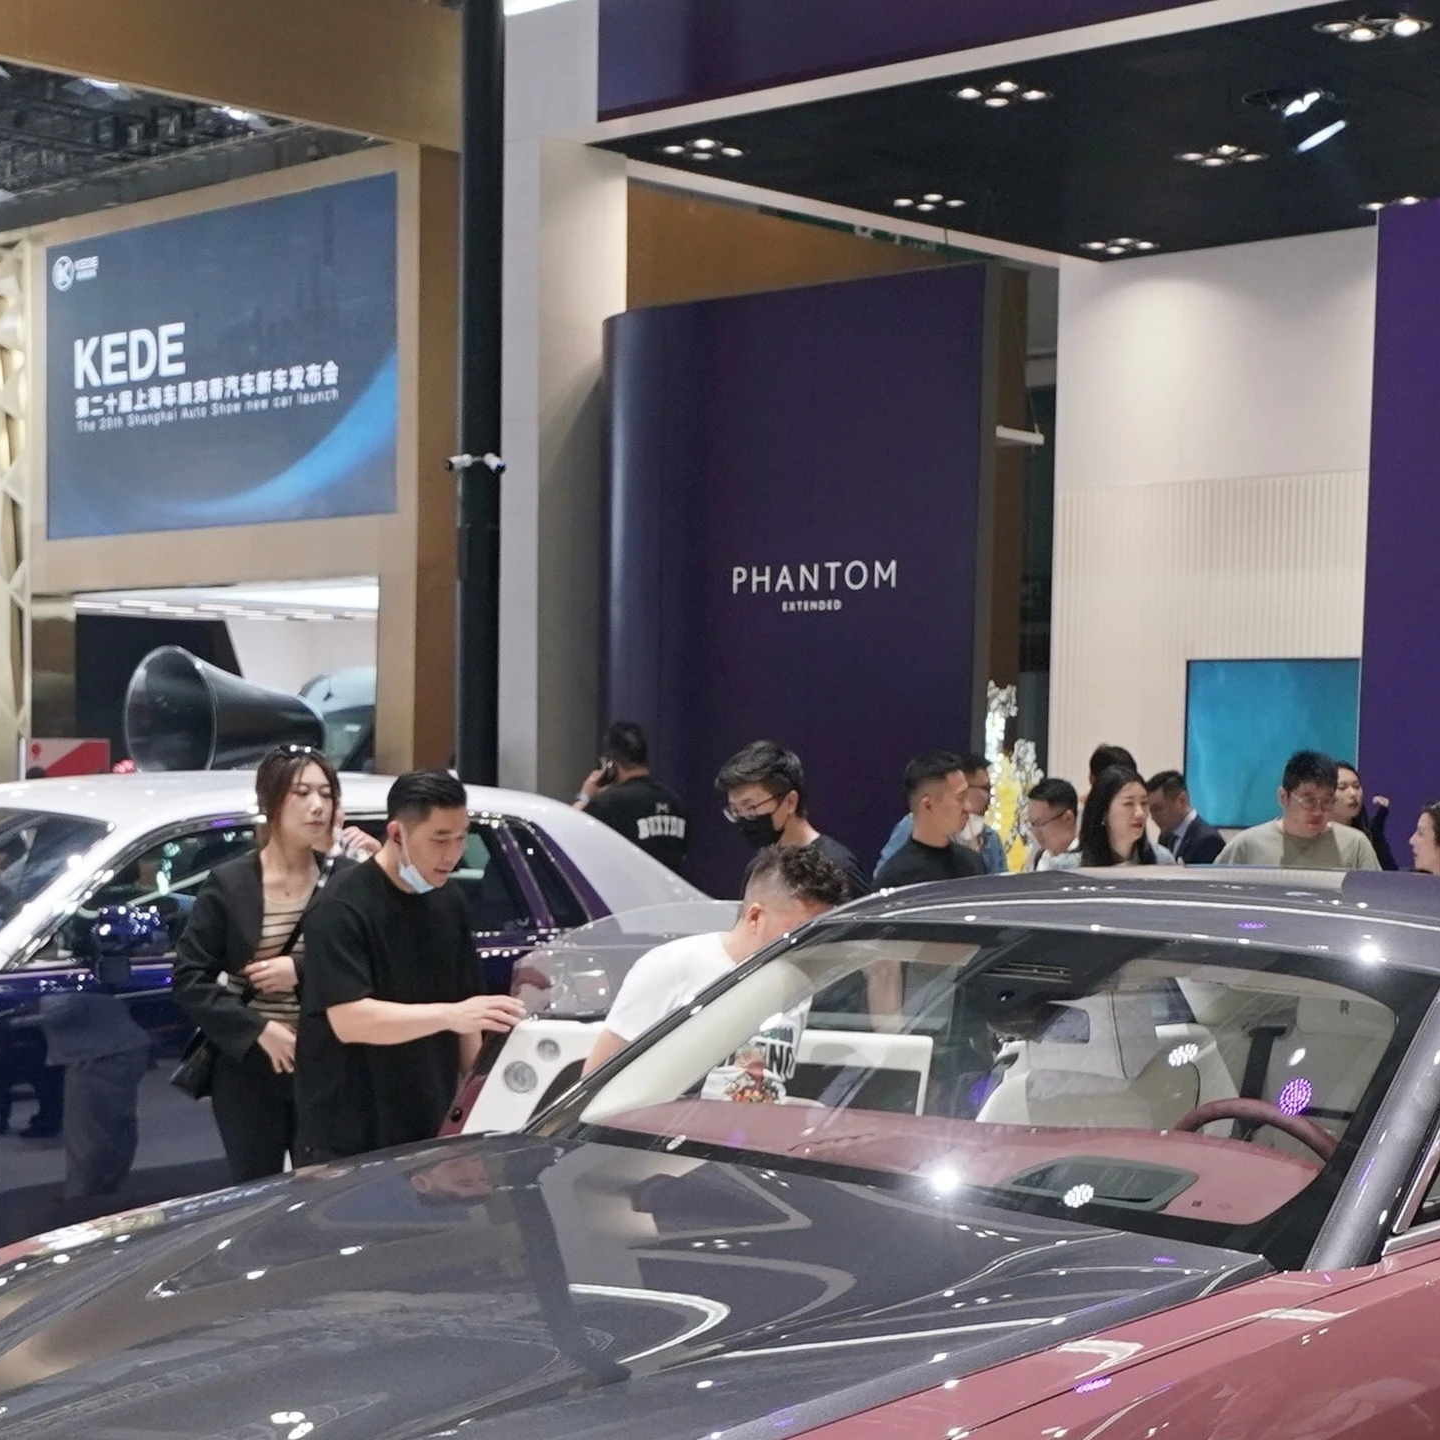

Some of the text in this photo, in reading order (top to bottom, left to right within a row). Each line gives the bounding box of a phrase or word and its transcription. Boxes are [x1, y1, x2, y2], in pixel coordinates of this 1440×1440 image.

[74, 322, 186, 388] KEDE
[126, 409, 178, 427] Shanghai
[180, 406, 207, 419] Auto
[210, 401, 241, 417] Show
[732, 559, 897, 594] PHANTOM
[781, 599, 842, 613] EXTENDED
